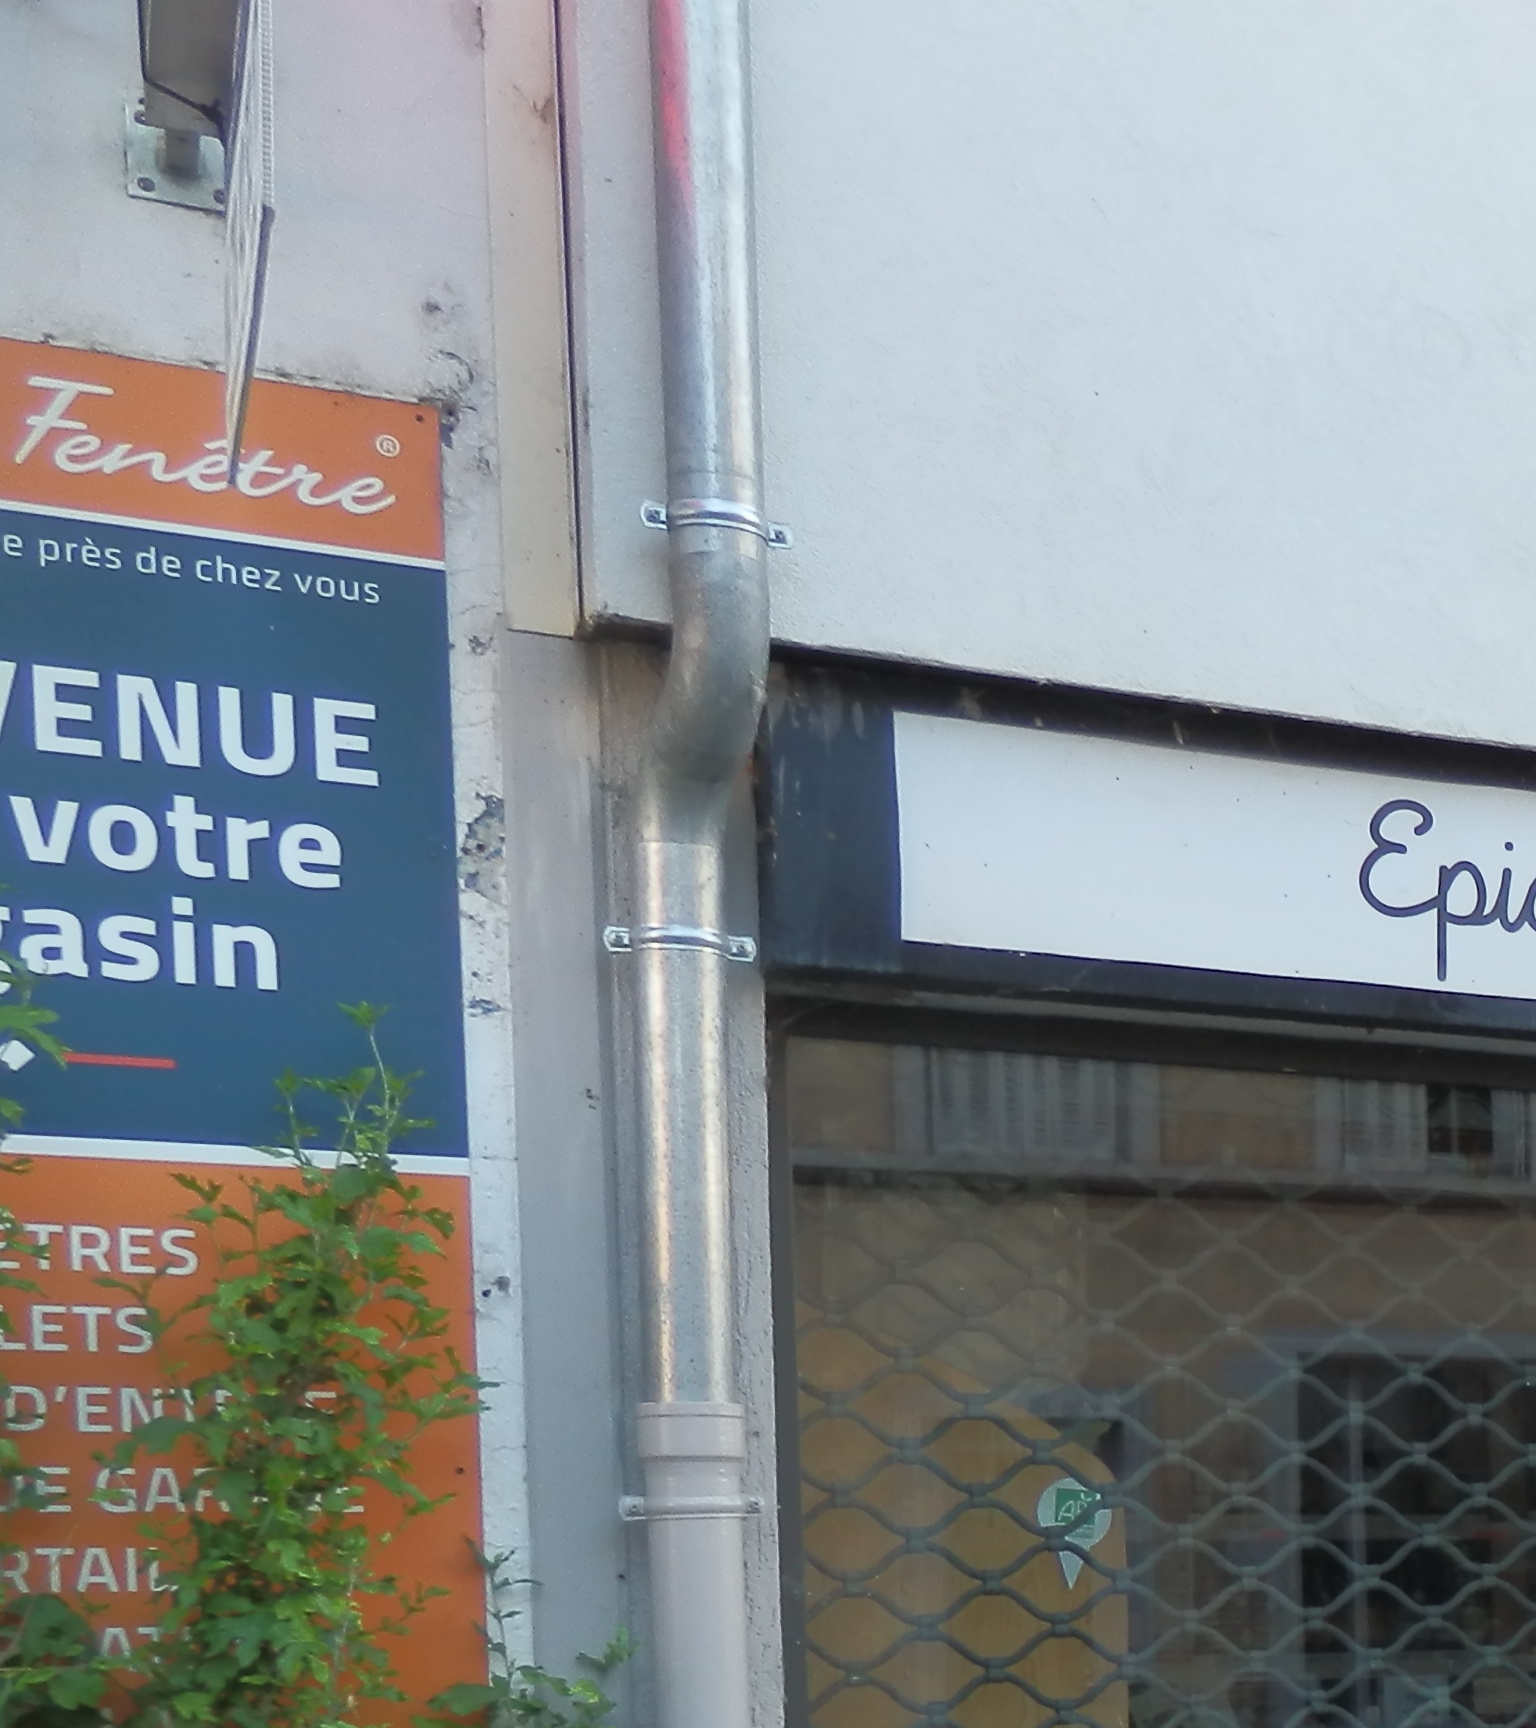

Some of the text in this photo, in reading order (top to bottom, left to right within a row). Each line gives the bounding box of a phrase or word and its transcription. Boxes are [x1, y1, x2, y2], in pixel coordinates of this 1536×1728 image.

[14, 374, 397, 515] Fenêtre
[38, 537, 123, 569] près
[135, 546, 182, 578] de
[195, 556, 283, 592] chez
[293, 572, 381, 604] vous
[0, 660, 380, 787] ENUE
[9, 794, 342, 889] votre
[0, 896, 279, 994] asin
